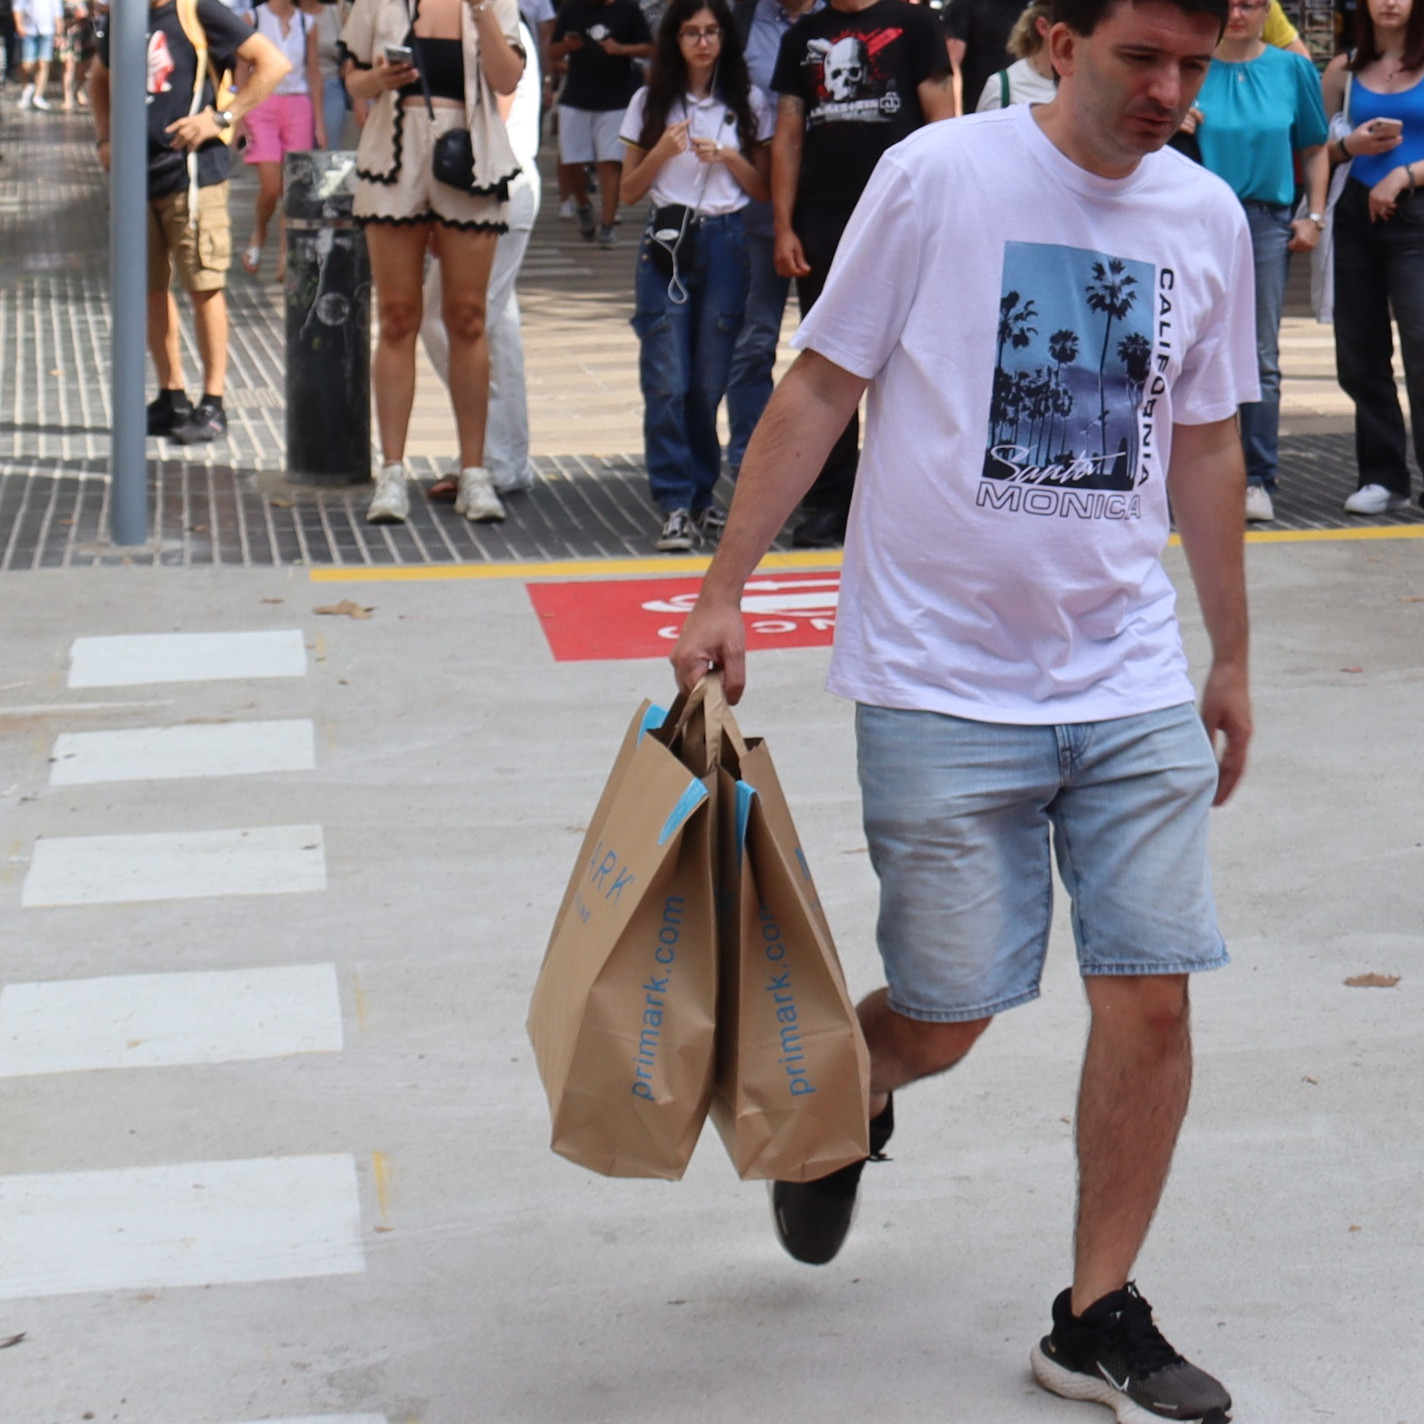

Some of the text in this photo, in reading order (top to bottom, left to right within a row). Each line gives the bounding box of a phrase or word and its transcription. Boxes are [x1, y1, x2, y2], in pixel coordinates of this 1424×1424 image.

[1137, 266, 1175, 488] CALIFORNIA
[975, 480, 1142, 521] MONICA
[990, 444, 1127, 485] Santa
[631, 894, 686, 1103] primark.com
